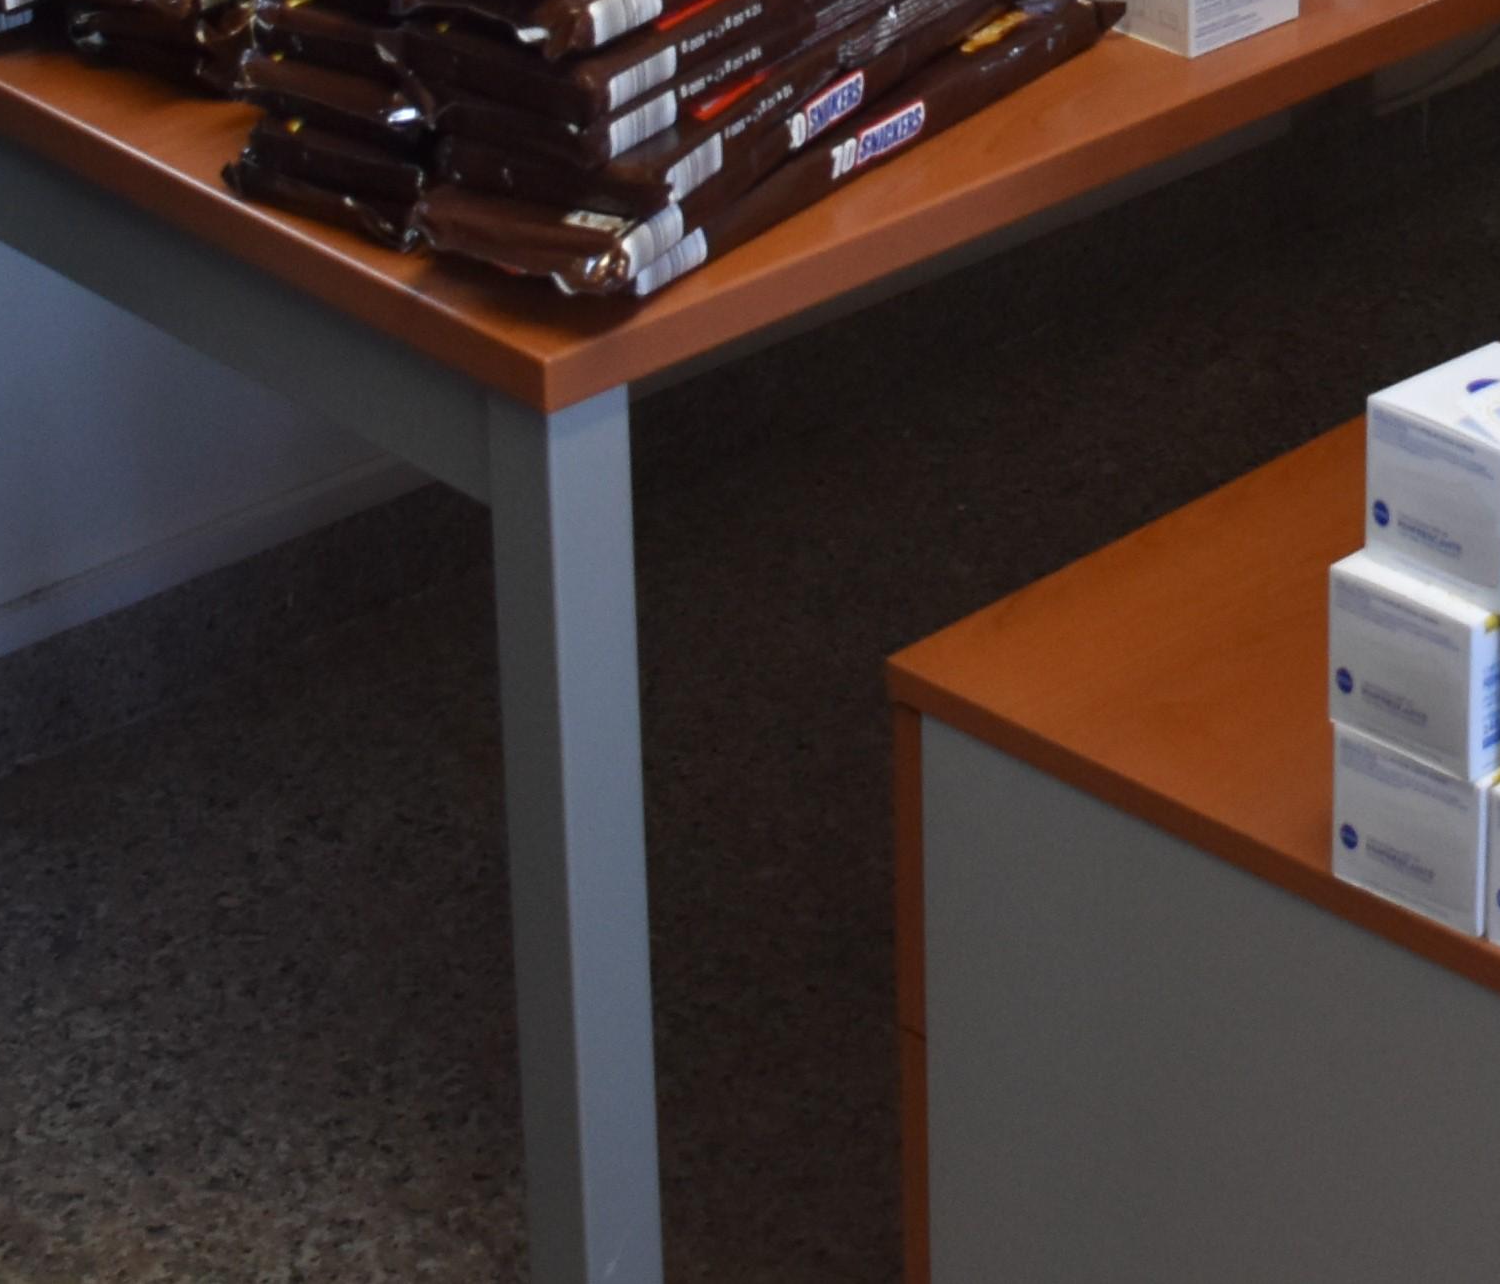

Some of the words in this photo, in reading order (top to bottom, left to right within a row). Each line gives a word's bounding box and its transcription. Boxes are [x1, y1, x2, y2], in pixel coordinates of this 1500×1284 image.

[808, 76, 863, 136] SNICKERS
[831, 137, 858, 179] 10
[860, 104, 923, 163] SNICKERS
